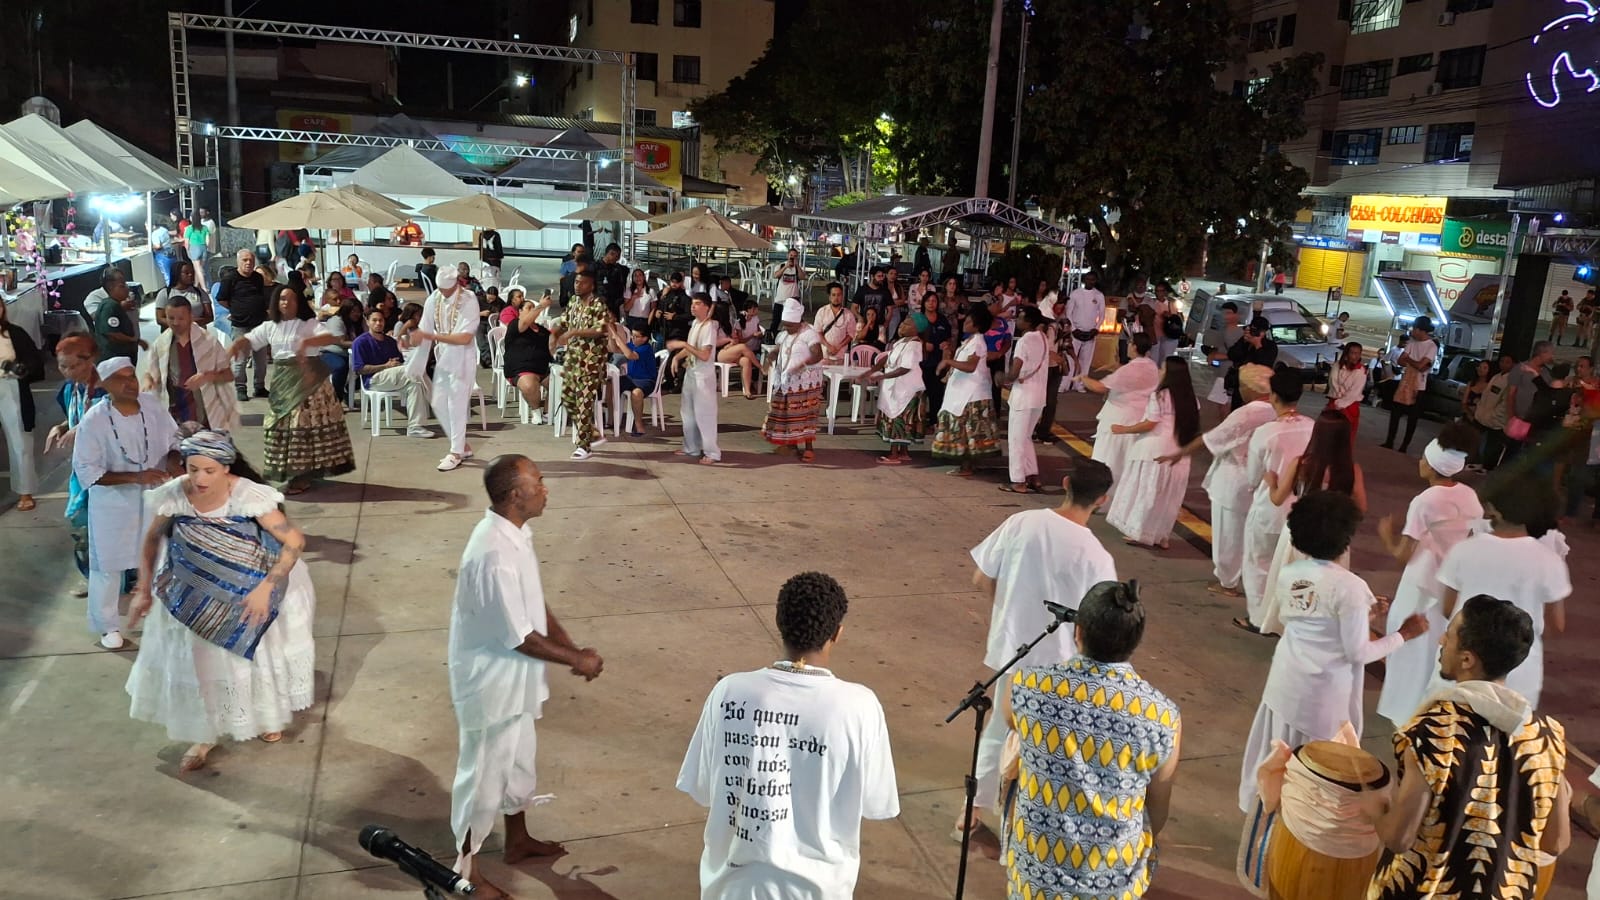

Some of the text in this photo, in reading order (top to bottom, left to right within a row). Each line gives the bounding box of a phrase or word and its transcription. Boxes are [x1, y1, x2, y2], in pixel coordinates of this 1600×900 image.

[753, 708, 799, 727] quem
[788, 735, 828, 757] sede
[757, 753, 791, 773] nós,
[746, 777, 793, 798] beber
[741, 803, 789, 822] nossa
